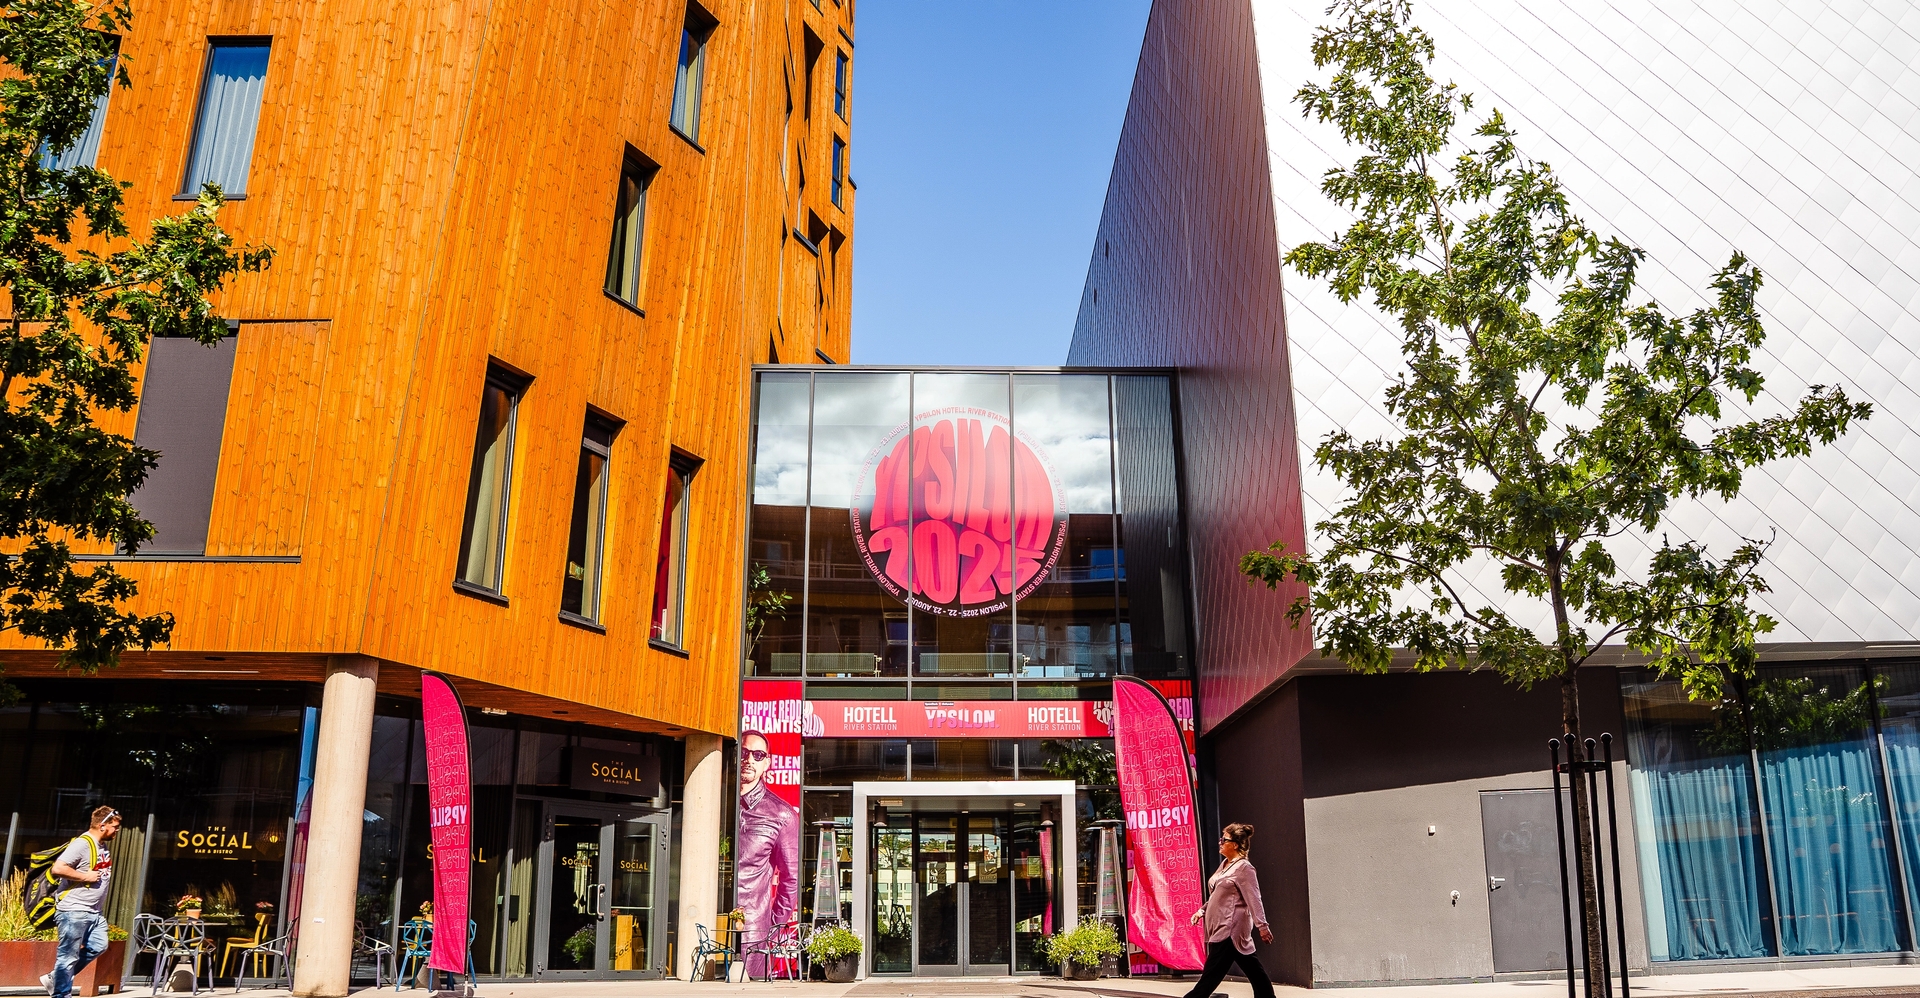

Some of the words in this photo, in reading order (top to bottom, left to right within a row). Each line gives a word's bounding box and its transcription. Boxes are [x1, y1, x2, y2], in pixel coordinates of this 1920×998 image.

[914, 408, 941, 422] YPSILON
[942, 406, 967, 414] HOTELL
[967, 407, 987, 417] RIVER
[870, 418, 1055, 551] YPSILON
[852, 507, 862, 534] STATION
[1055, 519, 1067, 548] YPSILON
[856, 534, 868, 553] RIVER
[864, 552, 881, 578] HOTELL
[868, 520, 1046, 605] 2025
[1044, 547, 1061, 569] HOTELL
[877, 573, 900, 596] YPSILON
[1034, 568, 1049, 586] RIVER
[1016, 583, 1035, 603] STATIO
[962, 609, 979, 617] 2025
[980, 601, 1008, 616] YPSILON
[743, 700, 777, 718] TRIPPIE
[778, 699, 802, 721] REDD
[844, 706, 897, 723] HOTELL
[1028, 707, 1081, 723] HOTELL
[742, 715, 802, 734] GALANTIS
[844, 723, 865, 731] RIVER
[867, 723, 897, 731] STATION
[1028, 723, 1049, 731] RIVER
[1052, 723, 1081, 731] STATION
[769, 754, 801, 769] ELEN
[591, 762, 642, 782] SOCIAL
[177, 830, 253, 849] SOCIAL
[620, 860, 648, 871] SOCIAL
